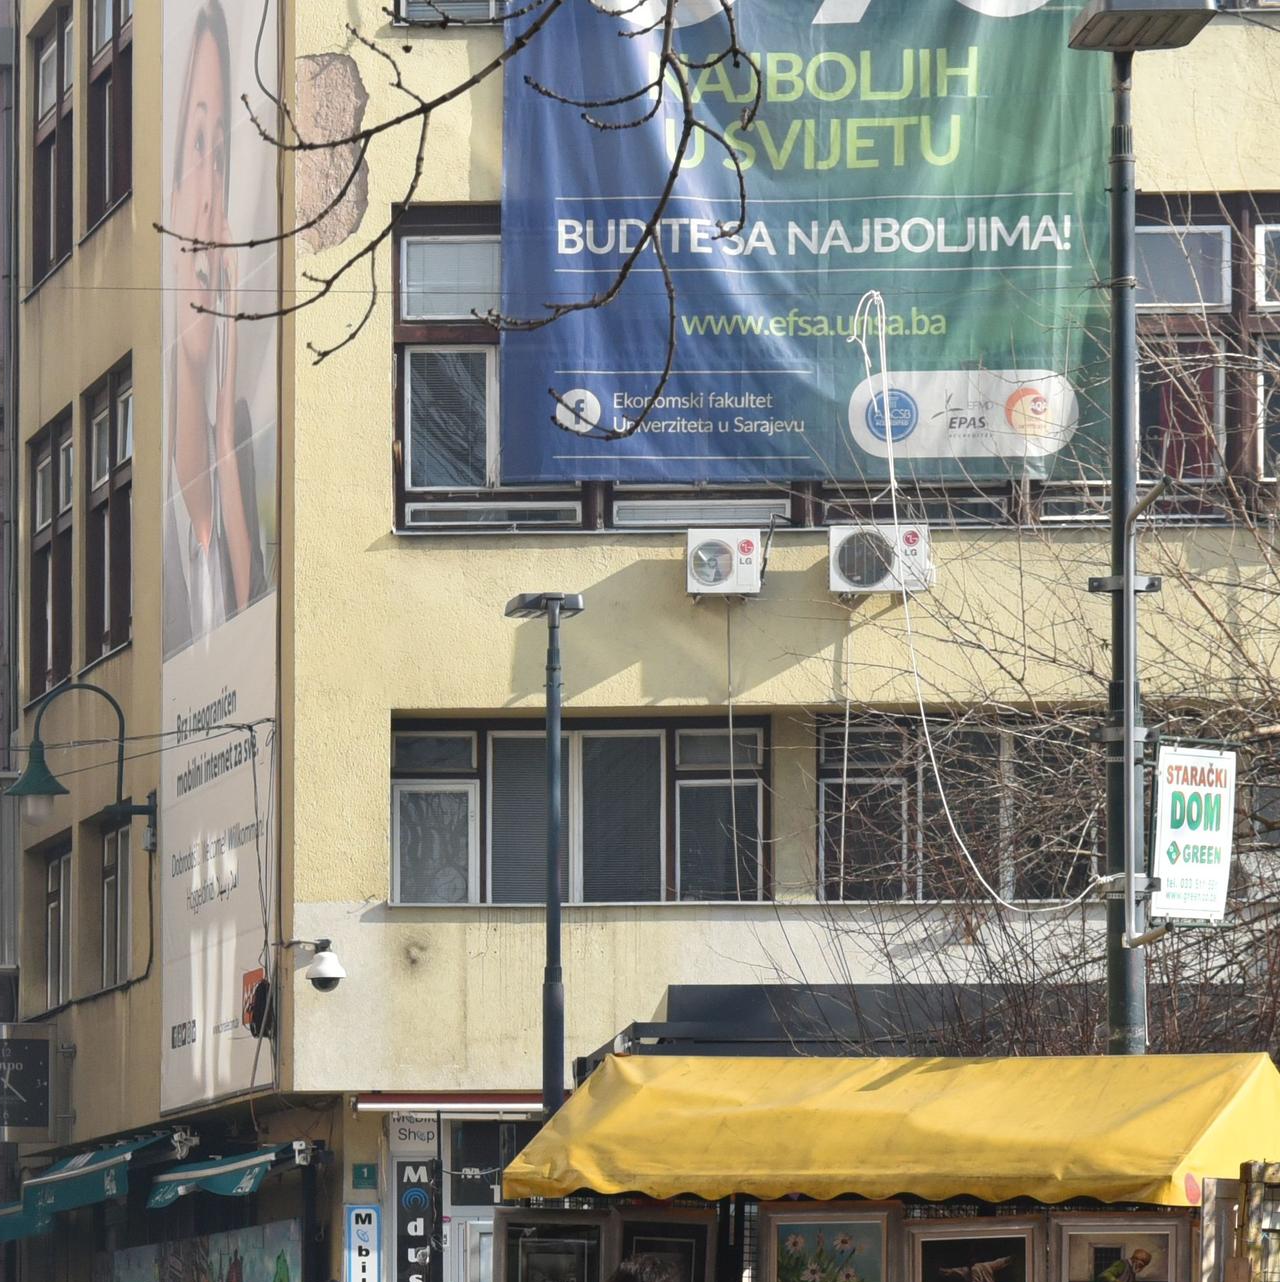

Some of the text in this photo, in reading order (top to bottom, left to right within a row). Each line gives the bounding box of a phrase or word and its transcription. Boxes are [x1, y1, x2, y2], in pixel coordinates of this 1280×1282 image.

[648, 46, 978, 103] NAJBOLJIH
[665, 114, 961, 170] U SVIJETU
[557, 214, 1072, 255] BUDITE SA NAJBOLJIMA!
[681, 308, 947, 337] www.efsa.unsa.ba
[613, 392, 704, 409] Ekonomski
[708, 392, 773, 408] fakultet
[613, 416, 805, 436] Univerziteta u Sarajevu
[948, 416, 986, 430] EPAS
[739, 557, 752, 565] LG
[904, 549, 917, 557] LG
[1166, 762, 1227, 788] STARAČKI
[1170, 790, 1222, 832] DOM
[1182, 844, 1222, 865] GREEN
[362, 1168, 368, 1178] 1
